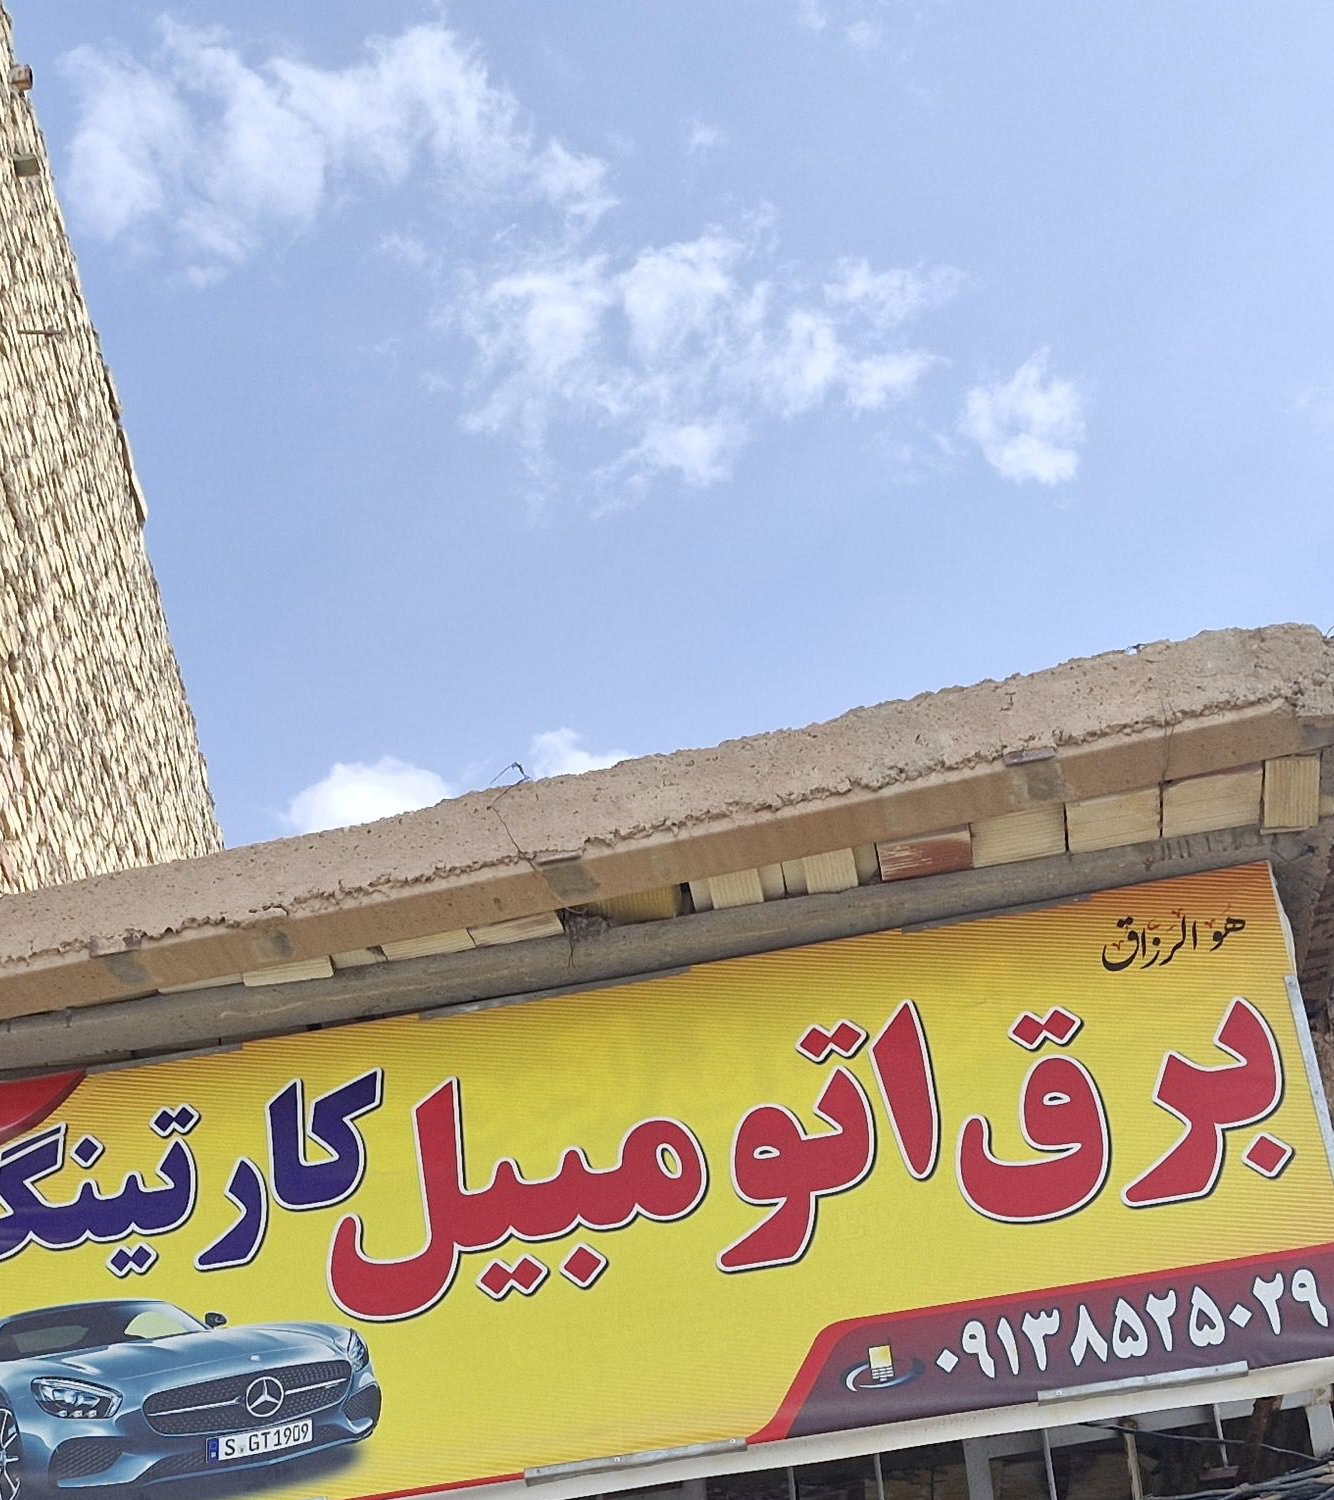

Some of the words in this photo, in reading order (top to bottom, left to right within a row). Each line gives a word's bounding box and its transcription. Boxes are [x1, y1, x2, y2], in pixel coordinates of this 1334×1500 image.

[328, 999, 940, 1323] اتومبیل
[955, 997, 1297, 1225] برق
[935, 1268, 1329, 1378] ۰۹۱۳۸۵۲۵۰۲۹
